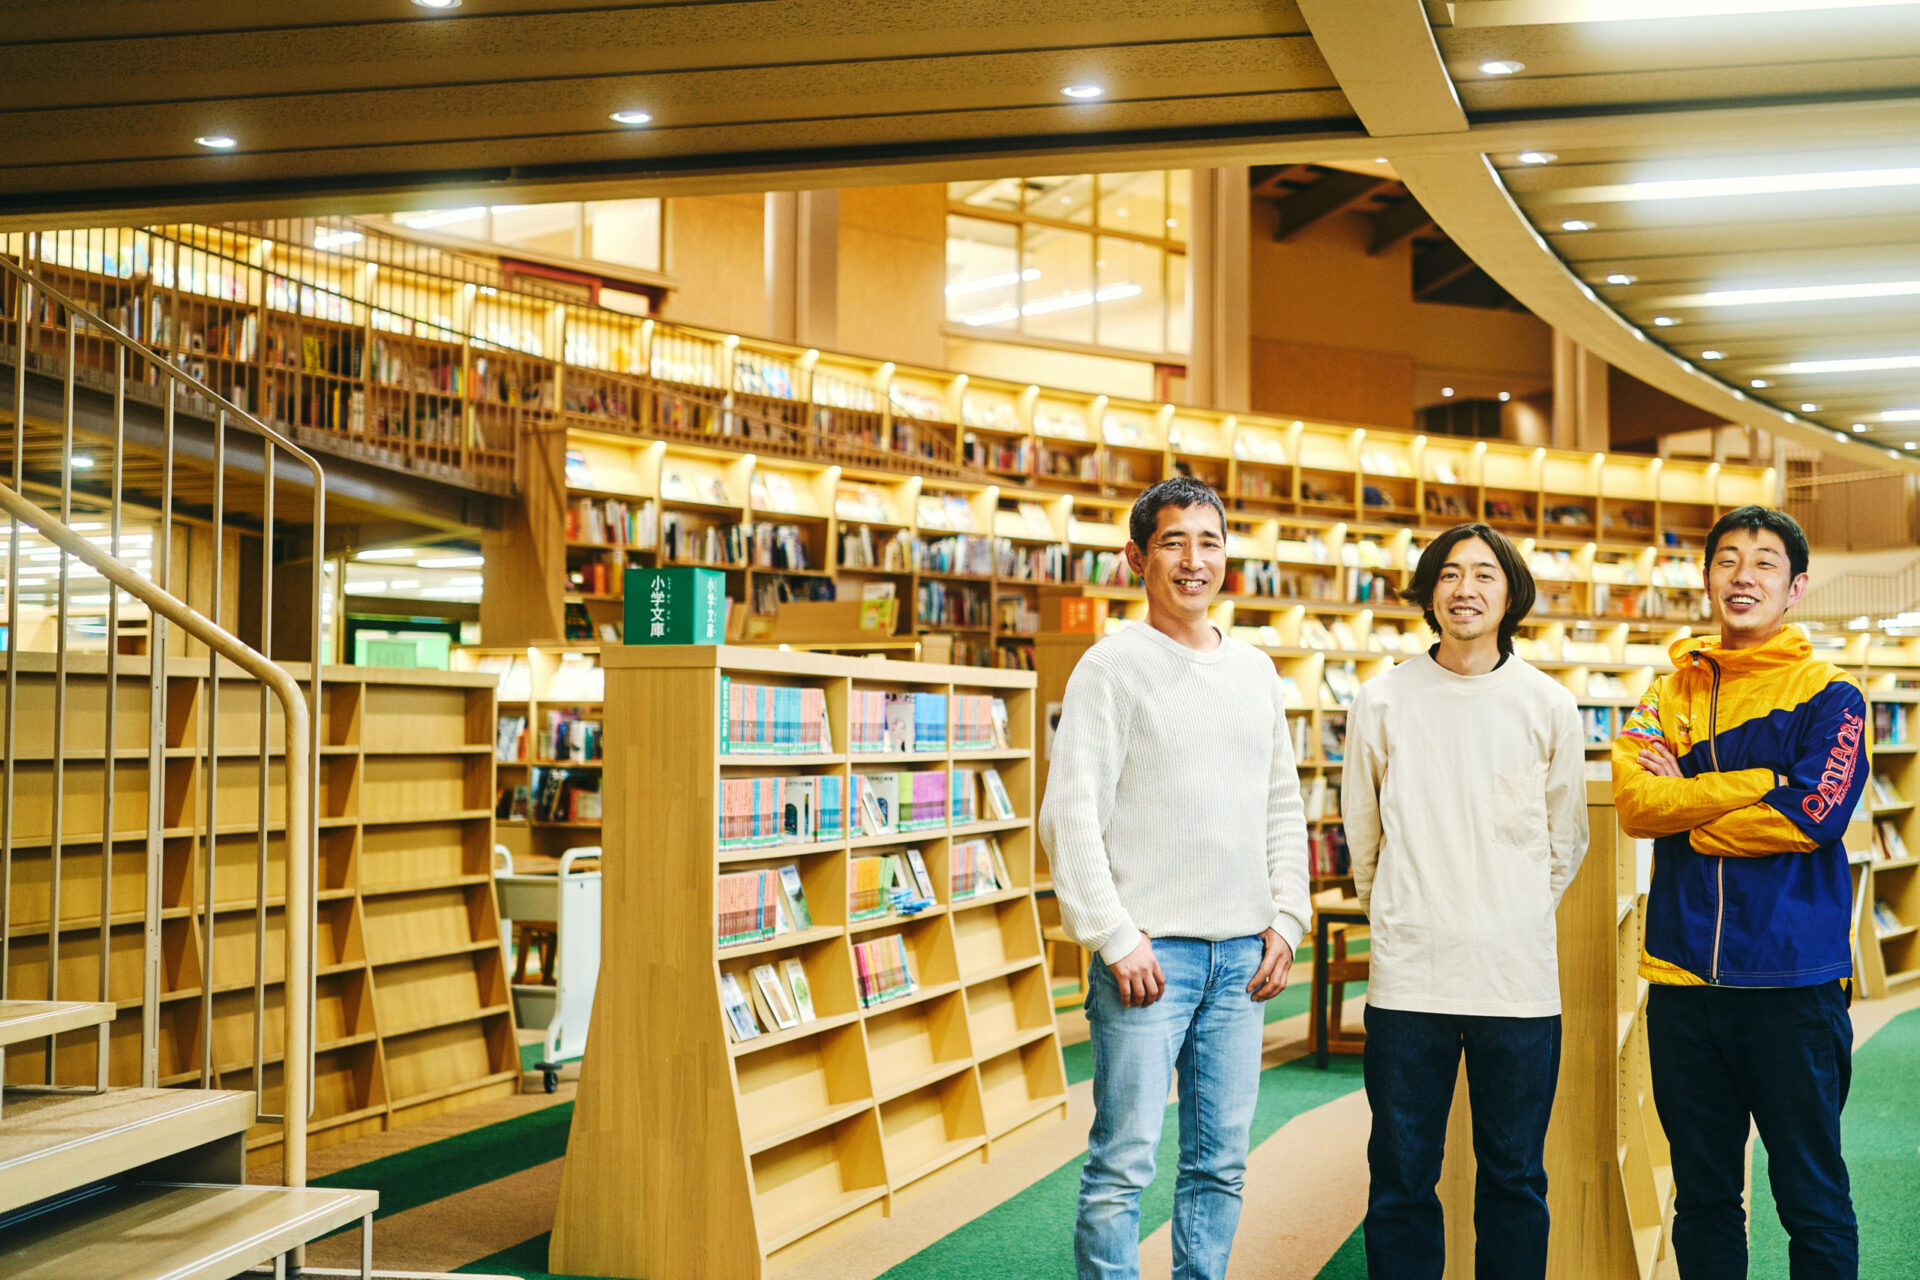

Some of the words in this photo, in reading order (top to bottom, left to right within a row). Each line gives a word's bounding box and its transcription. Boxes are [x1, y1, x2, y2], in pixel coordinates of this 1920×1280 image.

[650, 575, 665, 637] 小学文庫
[706, 577, 714, 638] 小学文庫
